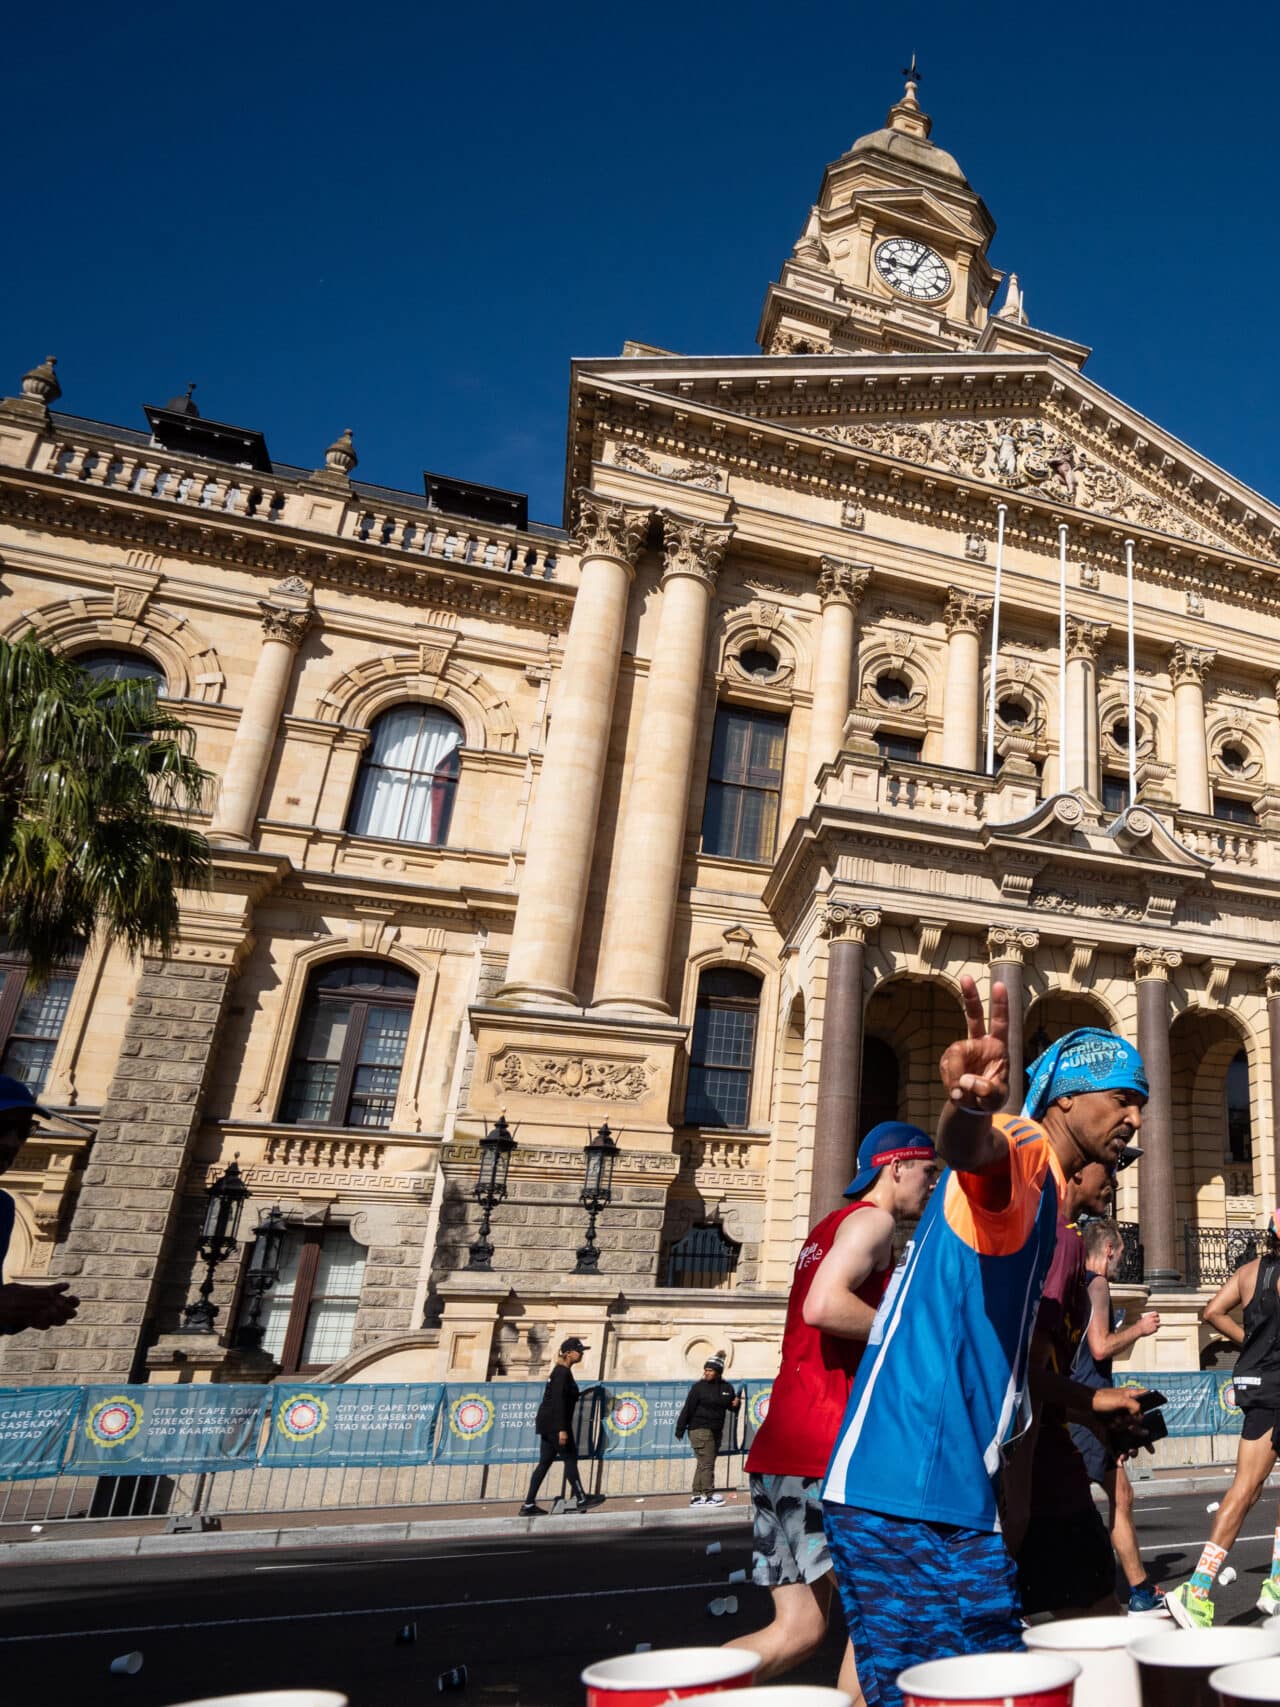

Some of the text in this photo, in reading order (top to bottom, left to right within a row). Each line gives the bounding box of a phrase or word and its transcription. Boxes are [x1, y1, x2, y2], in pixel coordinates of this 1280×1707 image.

[1060, 1041, 1122, 1060] AFRICAN
[1069, 1049, 1116, 1068] UNITY
[152, 1408, 177, 1416] CITY
[199, 1407, 226, 1415] CAPE
[230, 1407, 261, 1415] TOWN
[336, 1404, 358, 1412] CITY
[407, 1403, 435, 1411] TOWN
[1, 1410, 32, 1419] CAPE
[377, 1413, 426, 1421] SASEKAPA
[501, 1411, 536, 1419] ISIXEKO
[654, 1409, 680, 1417] ISIXEK
[150, 1417, 194, 1425] ISIXEKO
[653, 1418, 674, 1426] STAD
[147, 1426, 234, 1435] STAD KAAPSTAD
[334, 1422, 412, 1431] STAD KAAPSTAD
[0, 1430, 42, 1439] APSTAD
